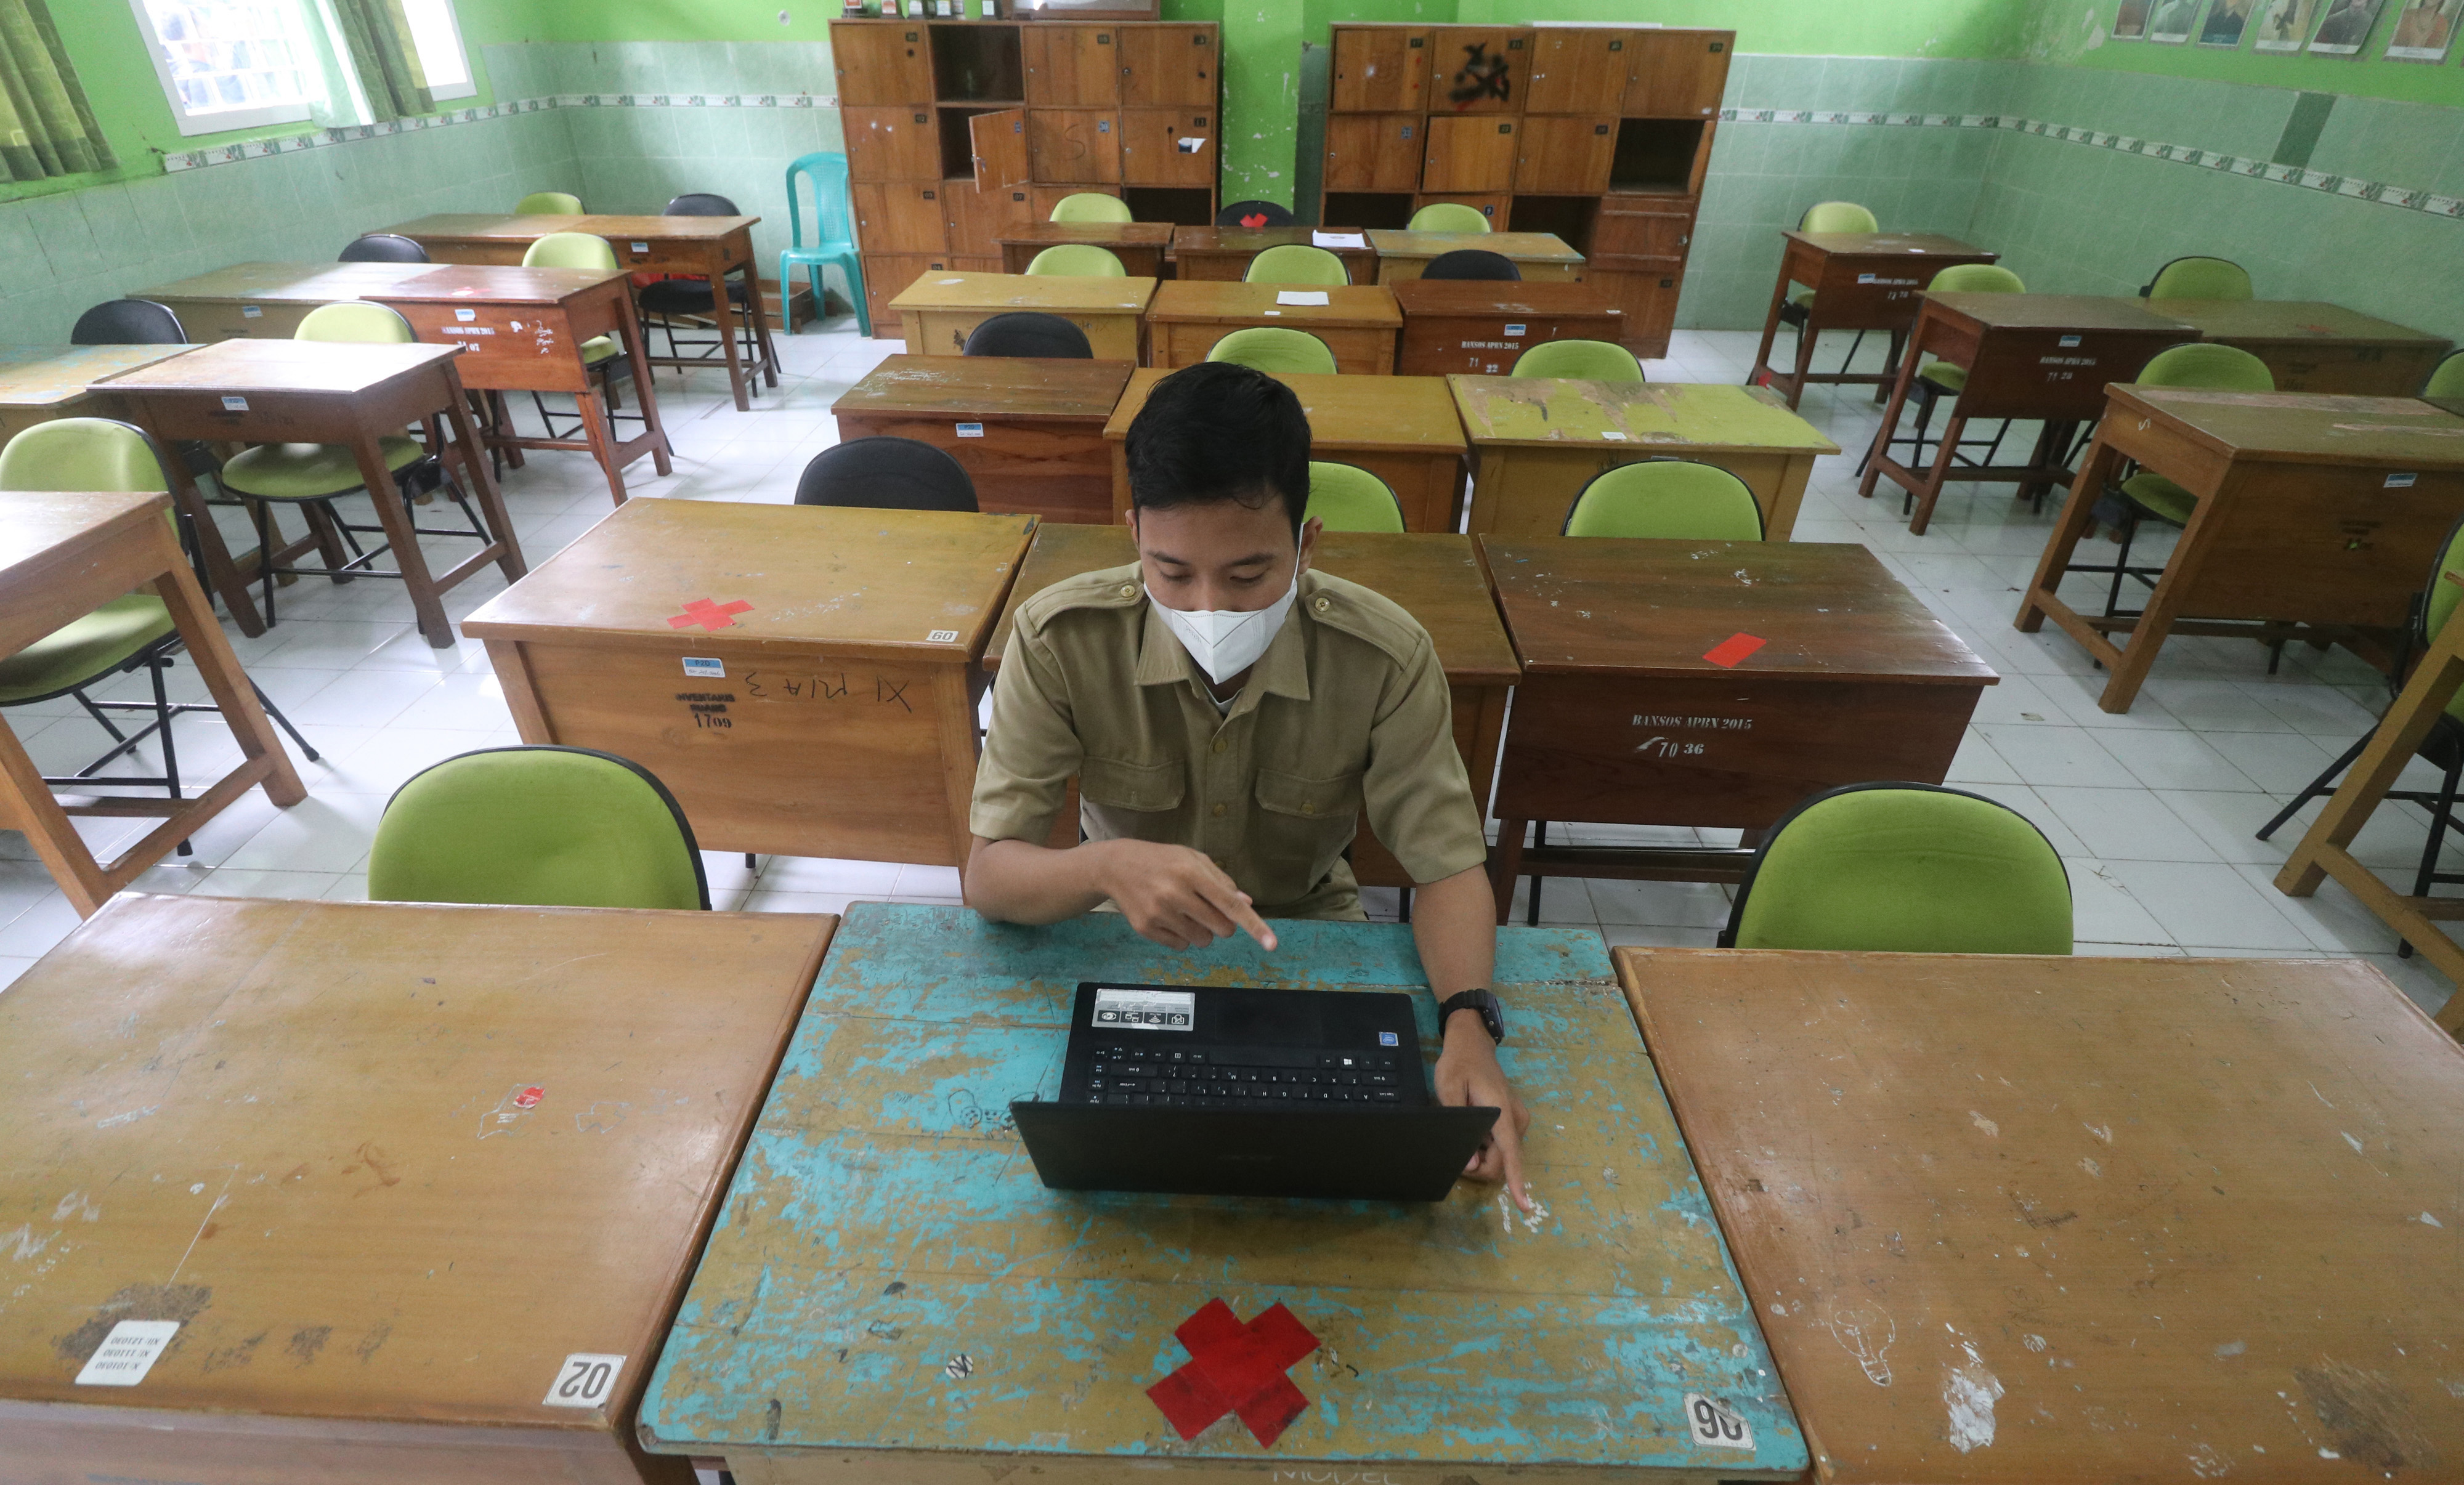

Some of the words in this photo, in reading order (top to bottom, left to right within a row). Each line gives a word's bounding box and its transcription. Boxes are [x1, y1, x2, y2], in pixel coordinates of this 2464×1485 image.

[1504, 342, 1520, 350] 2015
[745, 672, 768, 697] 3
[694, 713, 732, 728] 1709
[1632, 714, 1682, 727] BANSOS
[1721, 718, 1752, 731] 2015
[1658, 742, 1679, 758] 70
[1683, 743, 1705, 755] 36
[559, 1362, 612, 1399] 02
